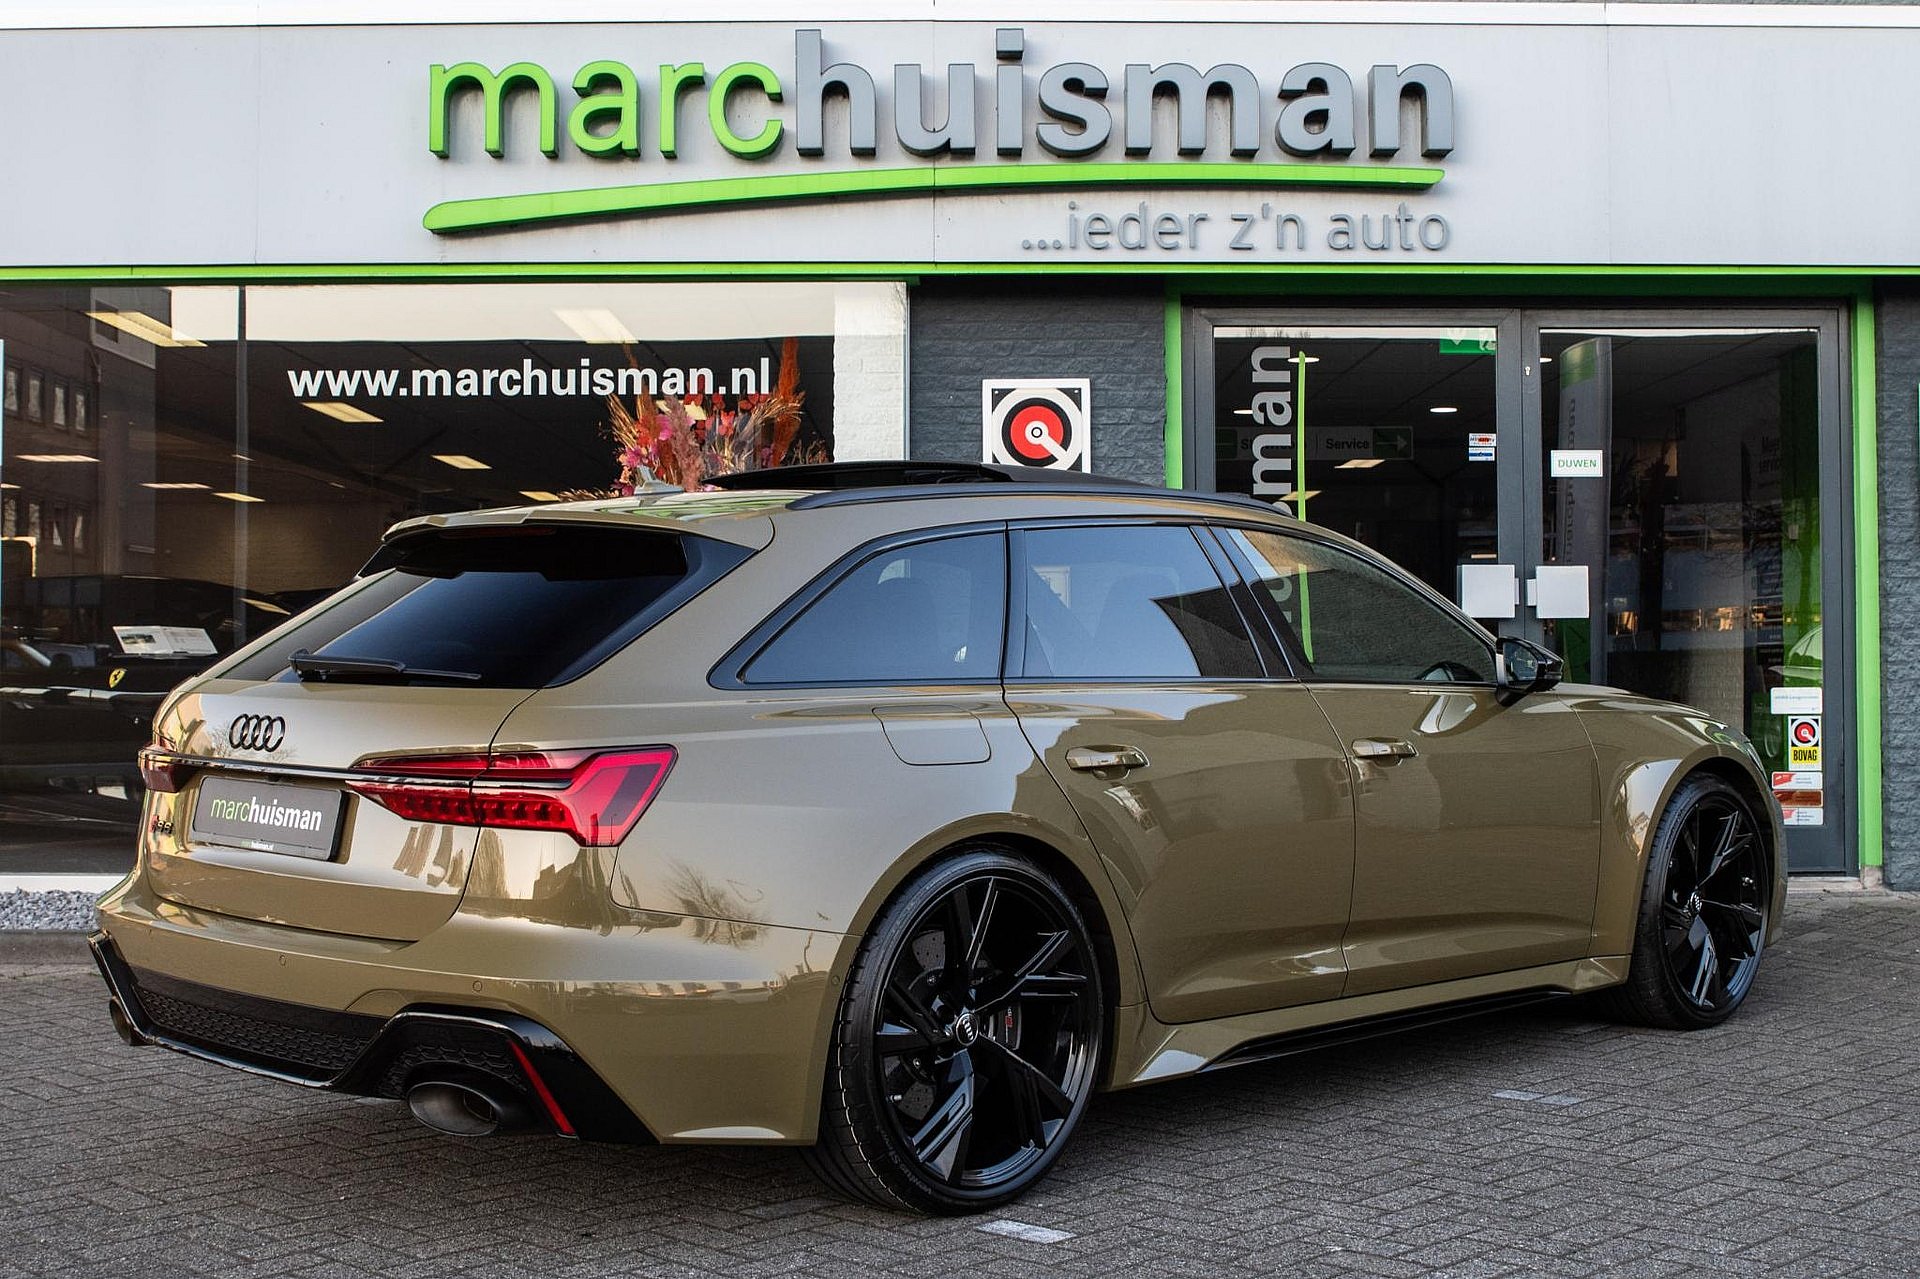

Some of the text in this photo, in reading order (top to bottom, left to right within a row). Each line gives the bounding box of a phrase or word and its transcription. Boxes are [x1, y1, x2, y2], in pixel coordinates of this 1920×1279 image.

[429, 28, 1455, 160] marchuisman
[1229, 202, 1305, 250] z'n
[1327, 202, 1451, 250] auto
[288, 357, 771, 399] www.marchuisman.nl
[1325, 438, 1370, 451] Service
[1557, 458, 1597, 469] DUWEN
[1793, 749, 1818, 762] BOVAG
[211, 797, 322, 831] marchuisman
